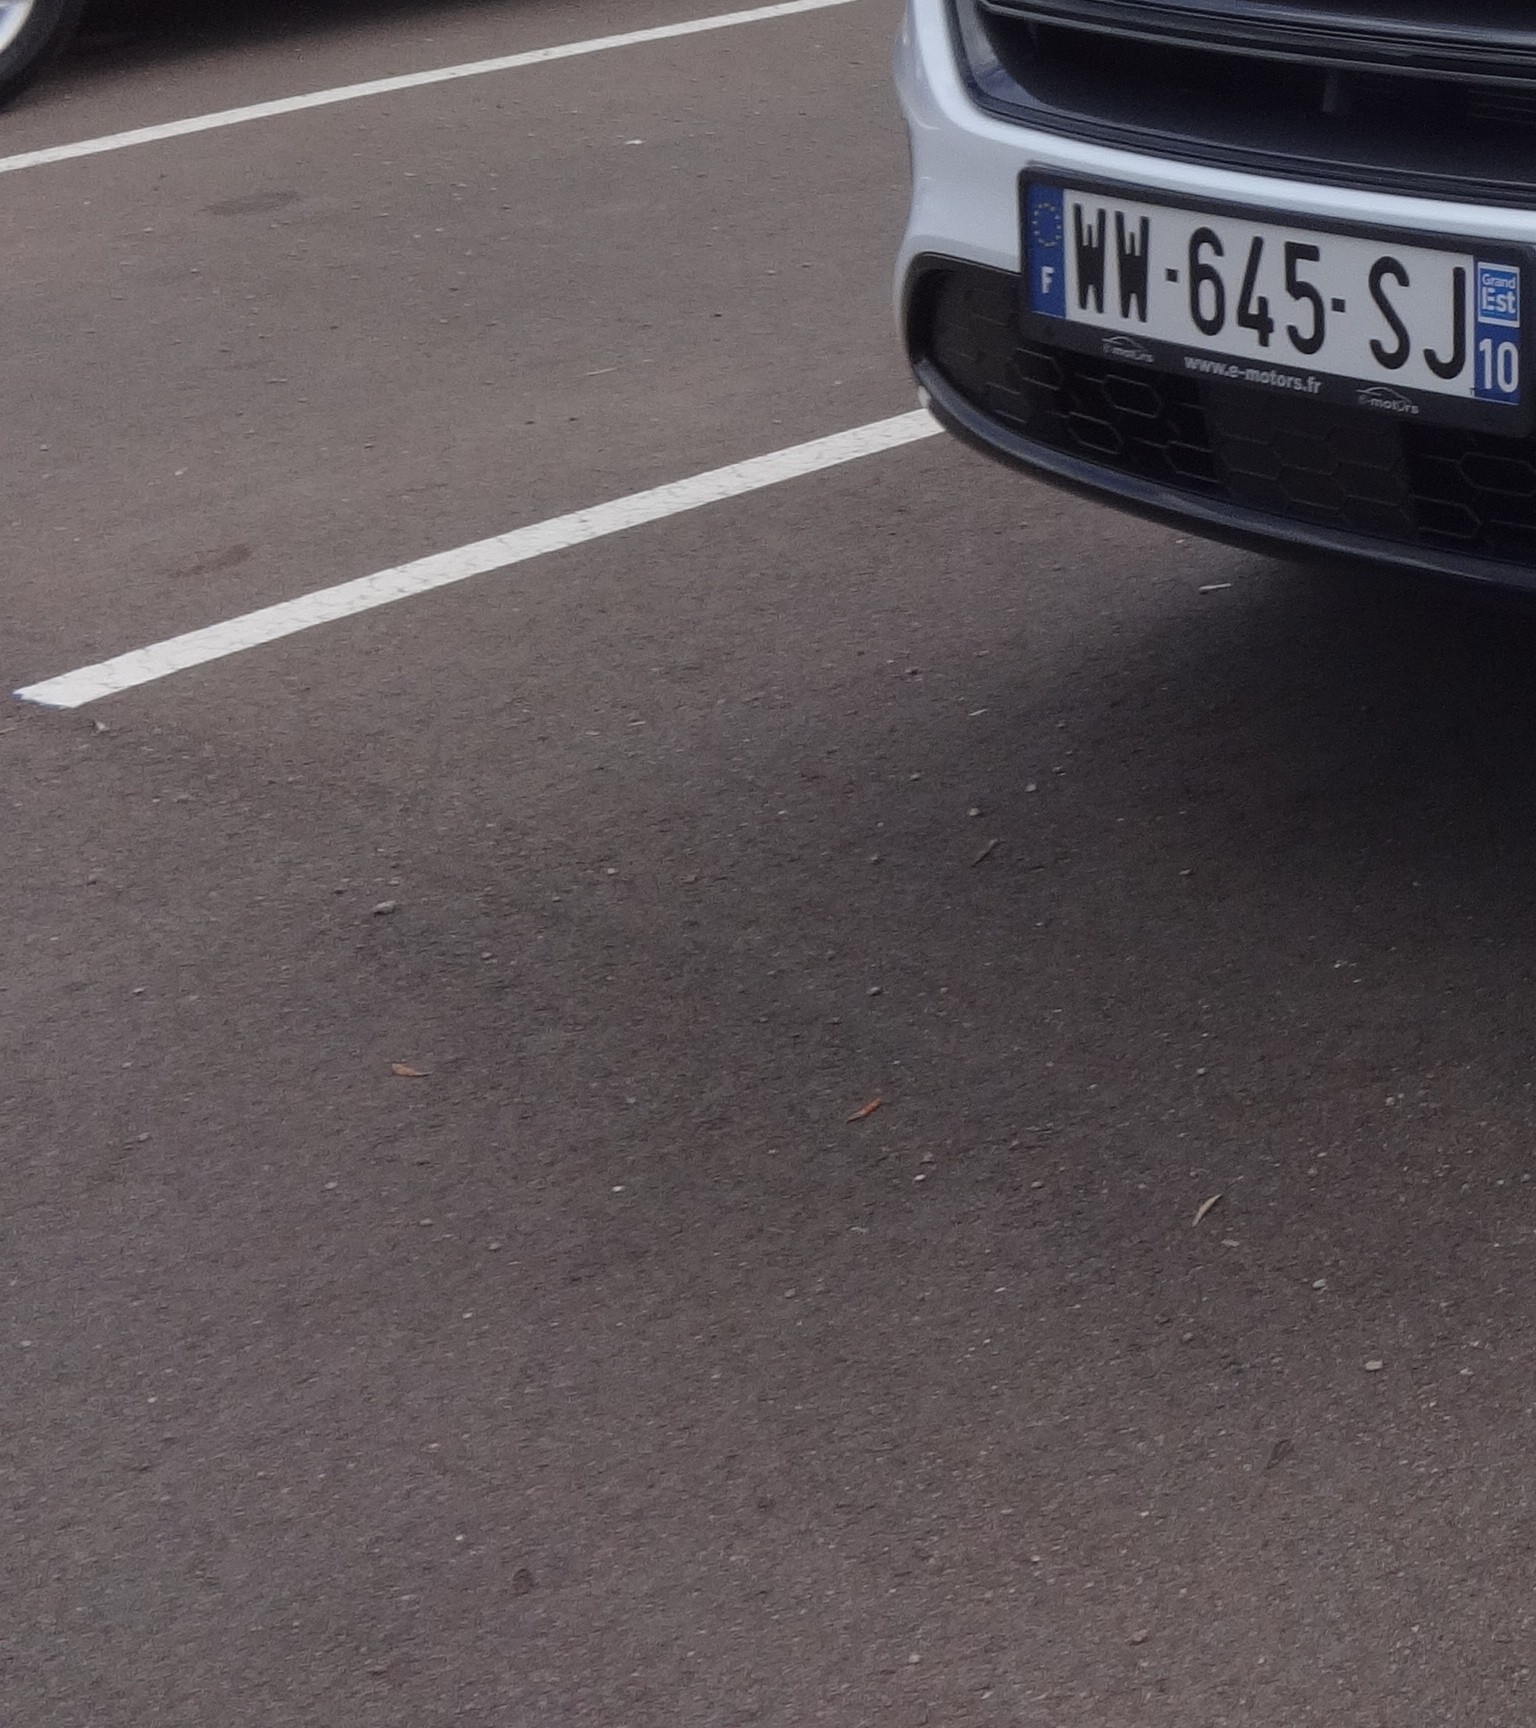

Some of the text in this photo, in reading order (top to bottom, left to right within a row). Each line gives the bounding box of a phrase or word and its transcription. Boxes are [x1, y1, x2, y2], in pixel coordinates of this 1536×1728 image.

[1040, 266, 1054, 296] F
[1072, 201, 1467, 381] WW-645-SJ
[1481, 273, 1516, 290] Grand
[1481, 286, 1516, 314] Est
[1183, 355, 1322, 395] www.e-motors.fr
[1479, 338, 1519, 393] 10
